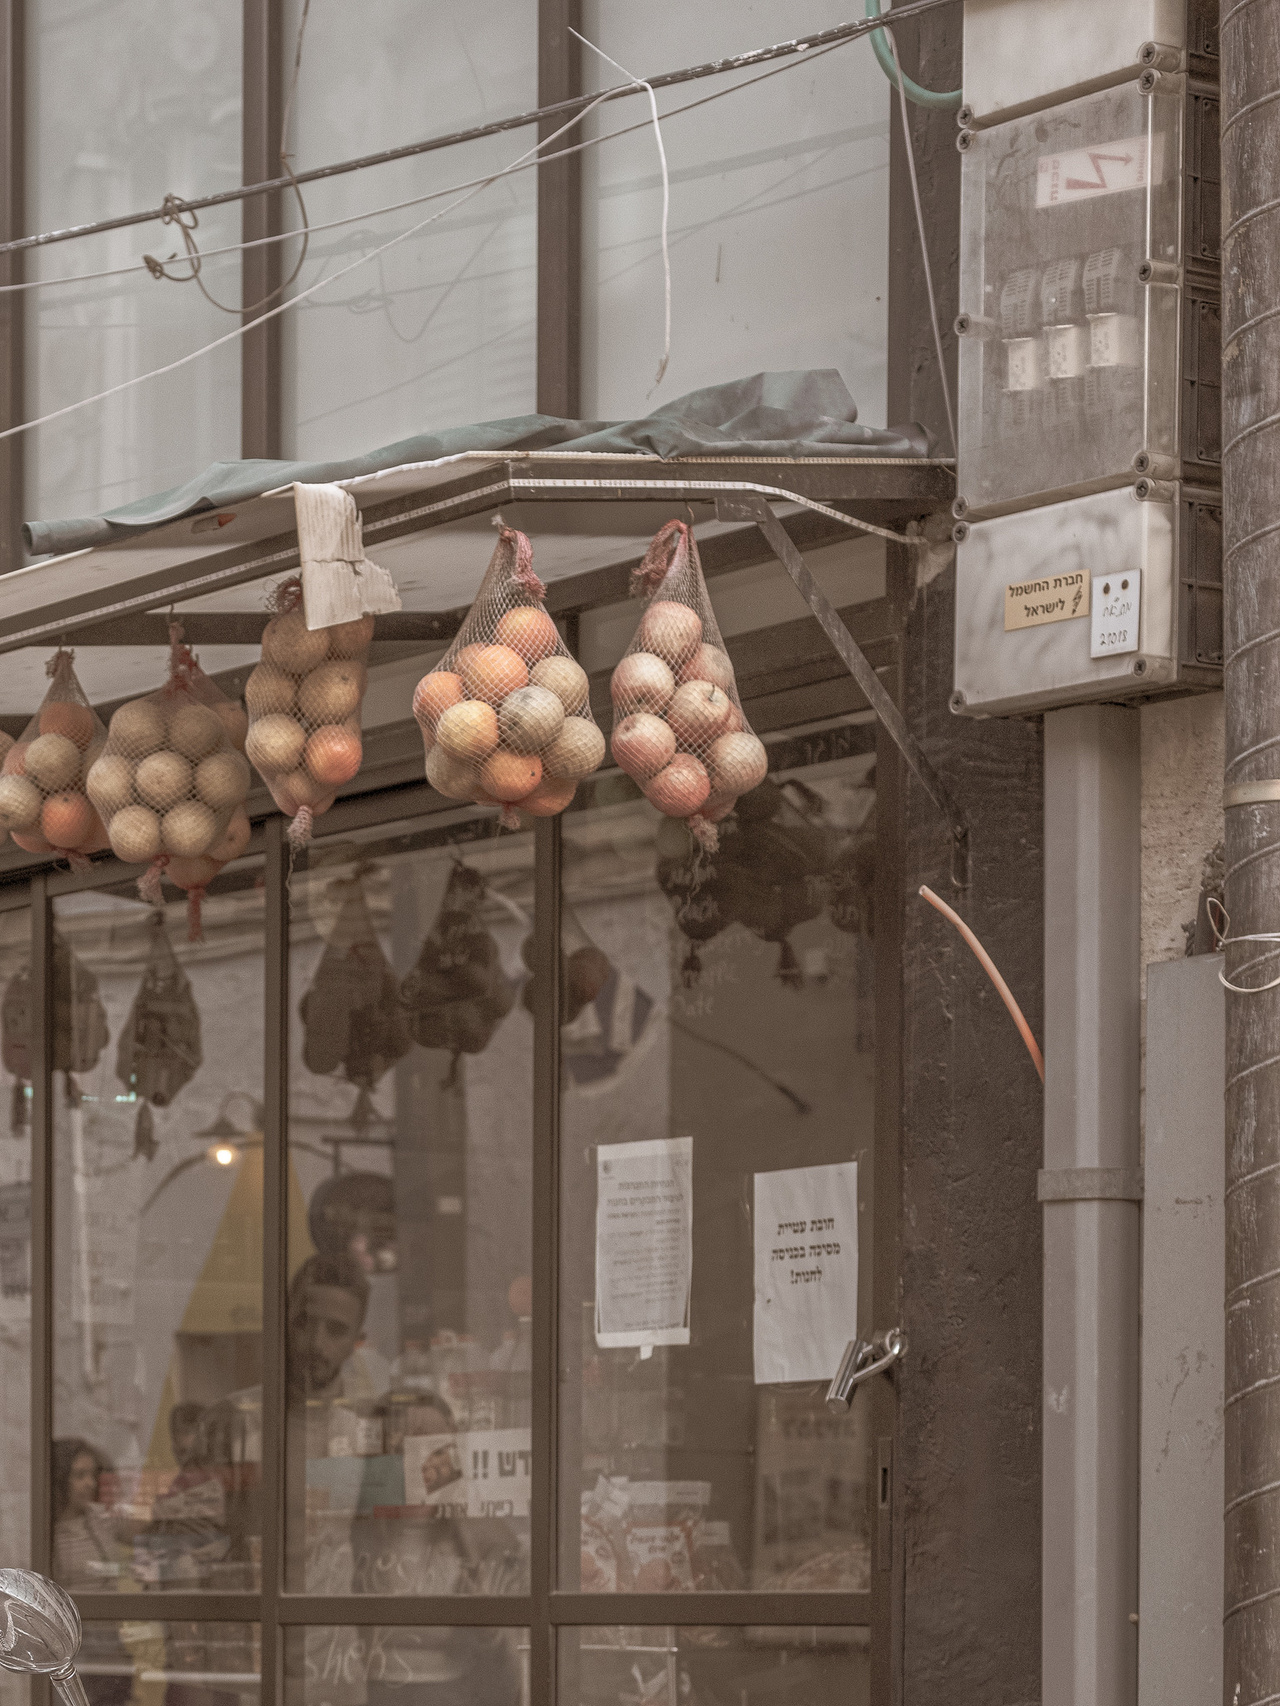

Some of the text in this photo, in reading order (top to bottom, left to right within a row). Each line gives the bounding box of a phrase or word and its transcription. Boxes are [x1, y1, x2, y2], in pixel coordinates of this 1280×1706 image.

[1008, 573, 1084, 598] חברת החשמל
[1024, 598, 1065, 618] לישראל
[777, 1218, 835, 1236] חובת עטיית
[771, 1242, 841, 1261] מסיכה בכניסה
[790, 1265, 823, 1285] לחנות!
